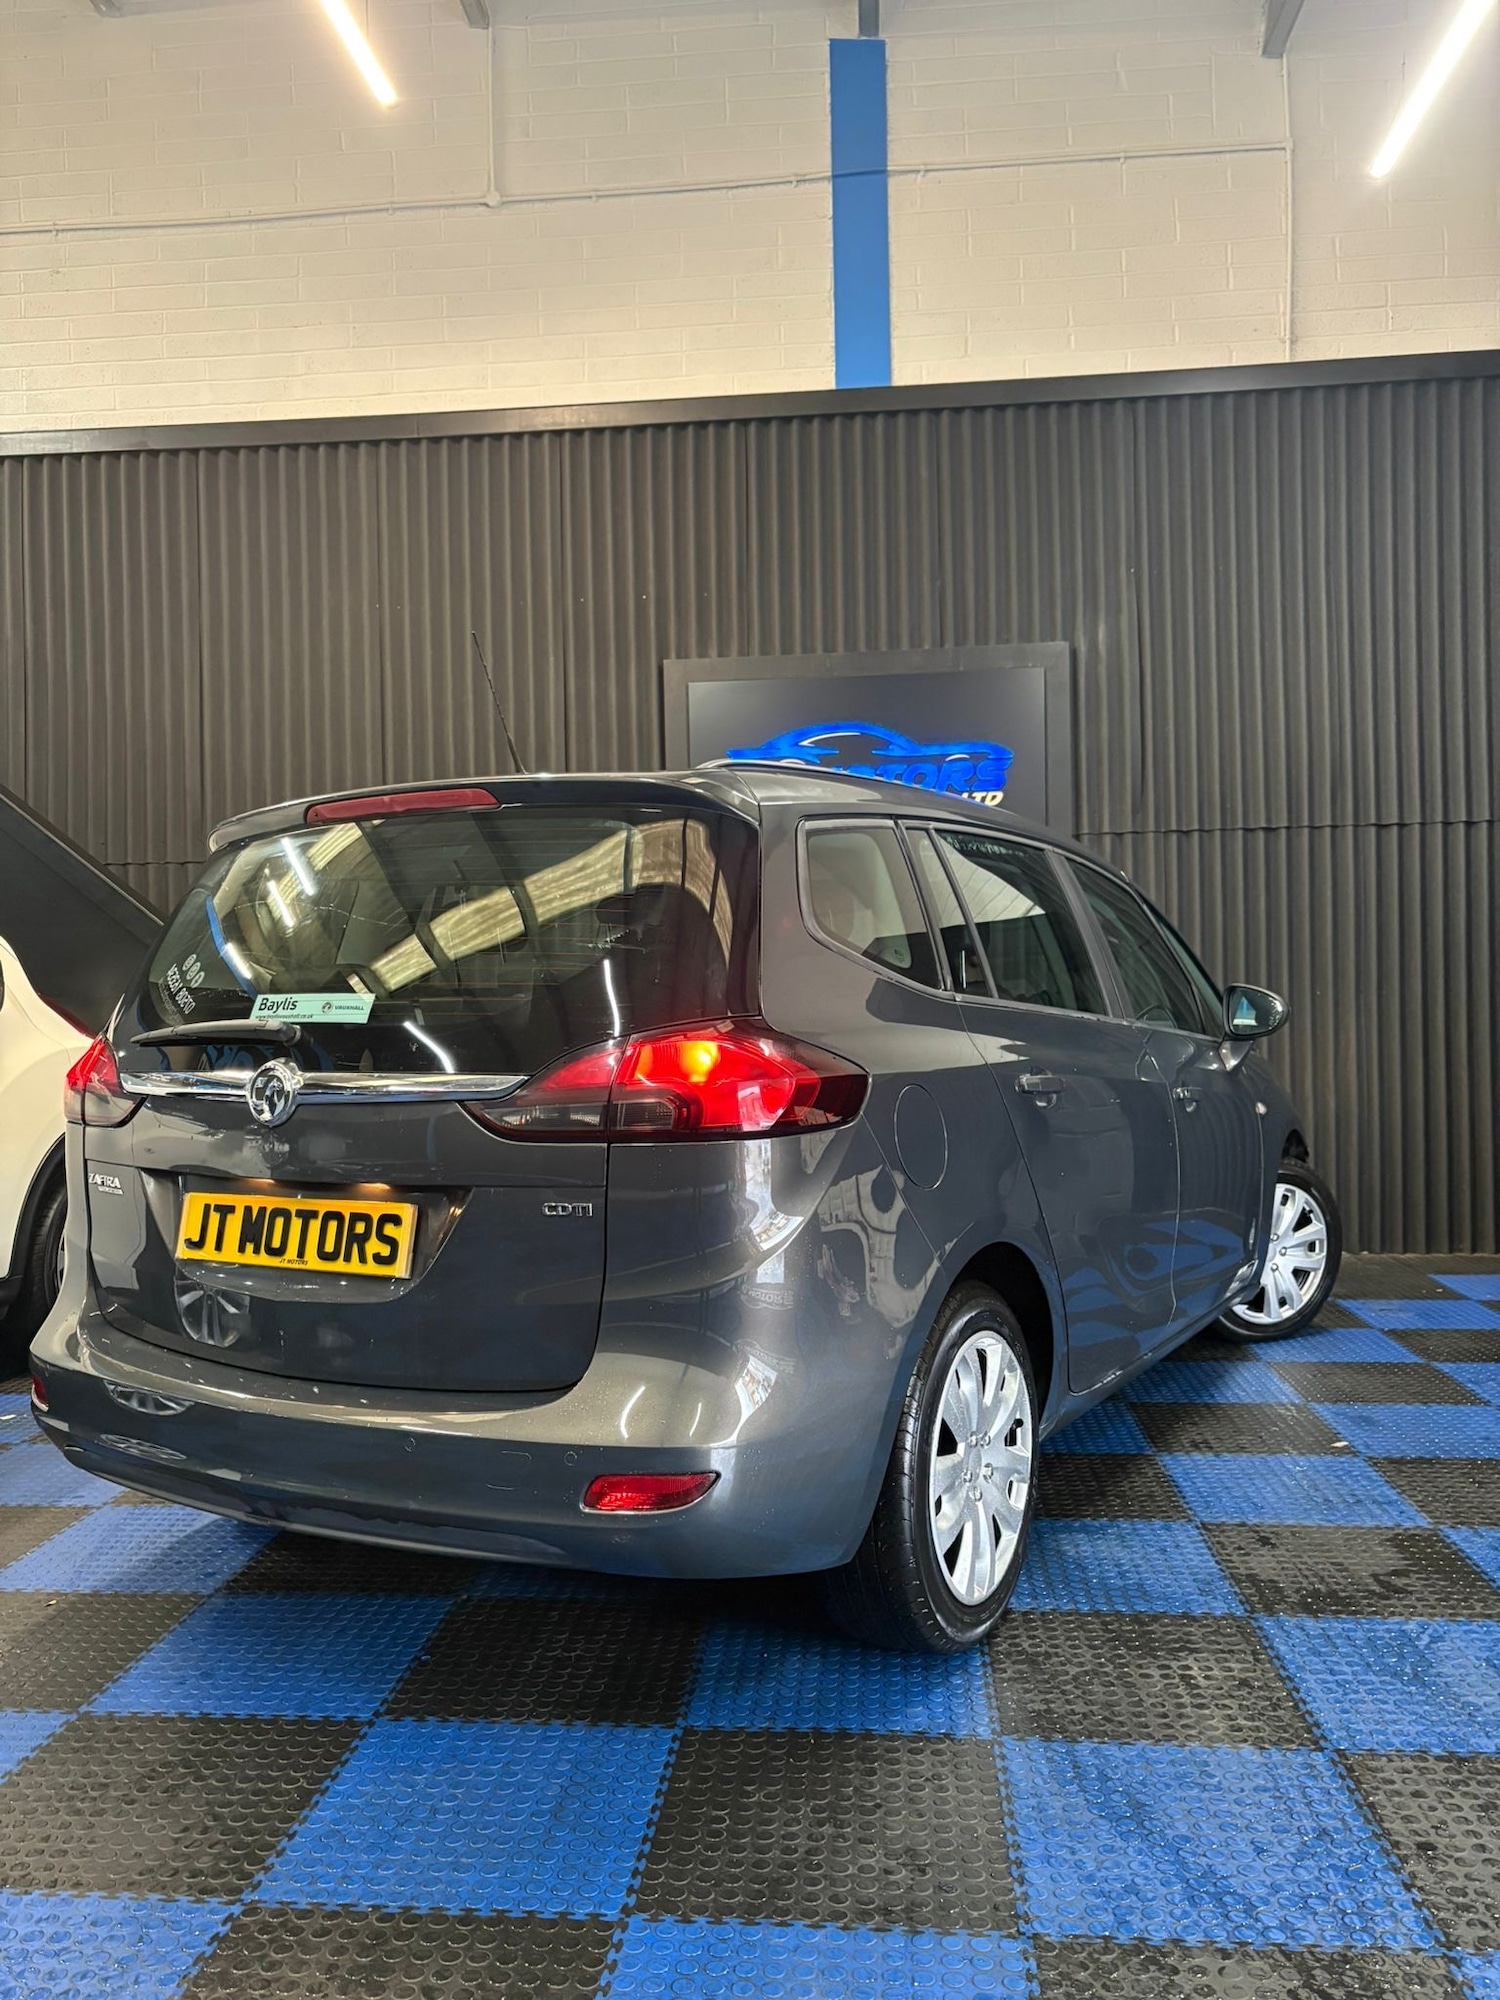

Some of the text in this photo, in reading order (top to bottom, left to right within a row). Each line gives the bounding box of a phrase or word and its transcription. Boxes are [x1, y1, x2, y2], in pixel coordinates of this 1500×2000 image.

[258, 997, 298, 1014] Baylis
[88, 1172, 121, 1189] ZAFIRA
[541, 1202, 593, 1217] CDTI
[184, 1203, 403, 1265] JT MOTORS
[287, 1258, 308, 1266] MOTORS
